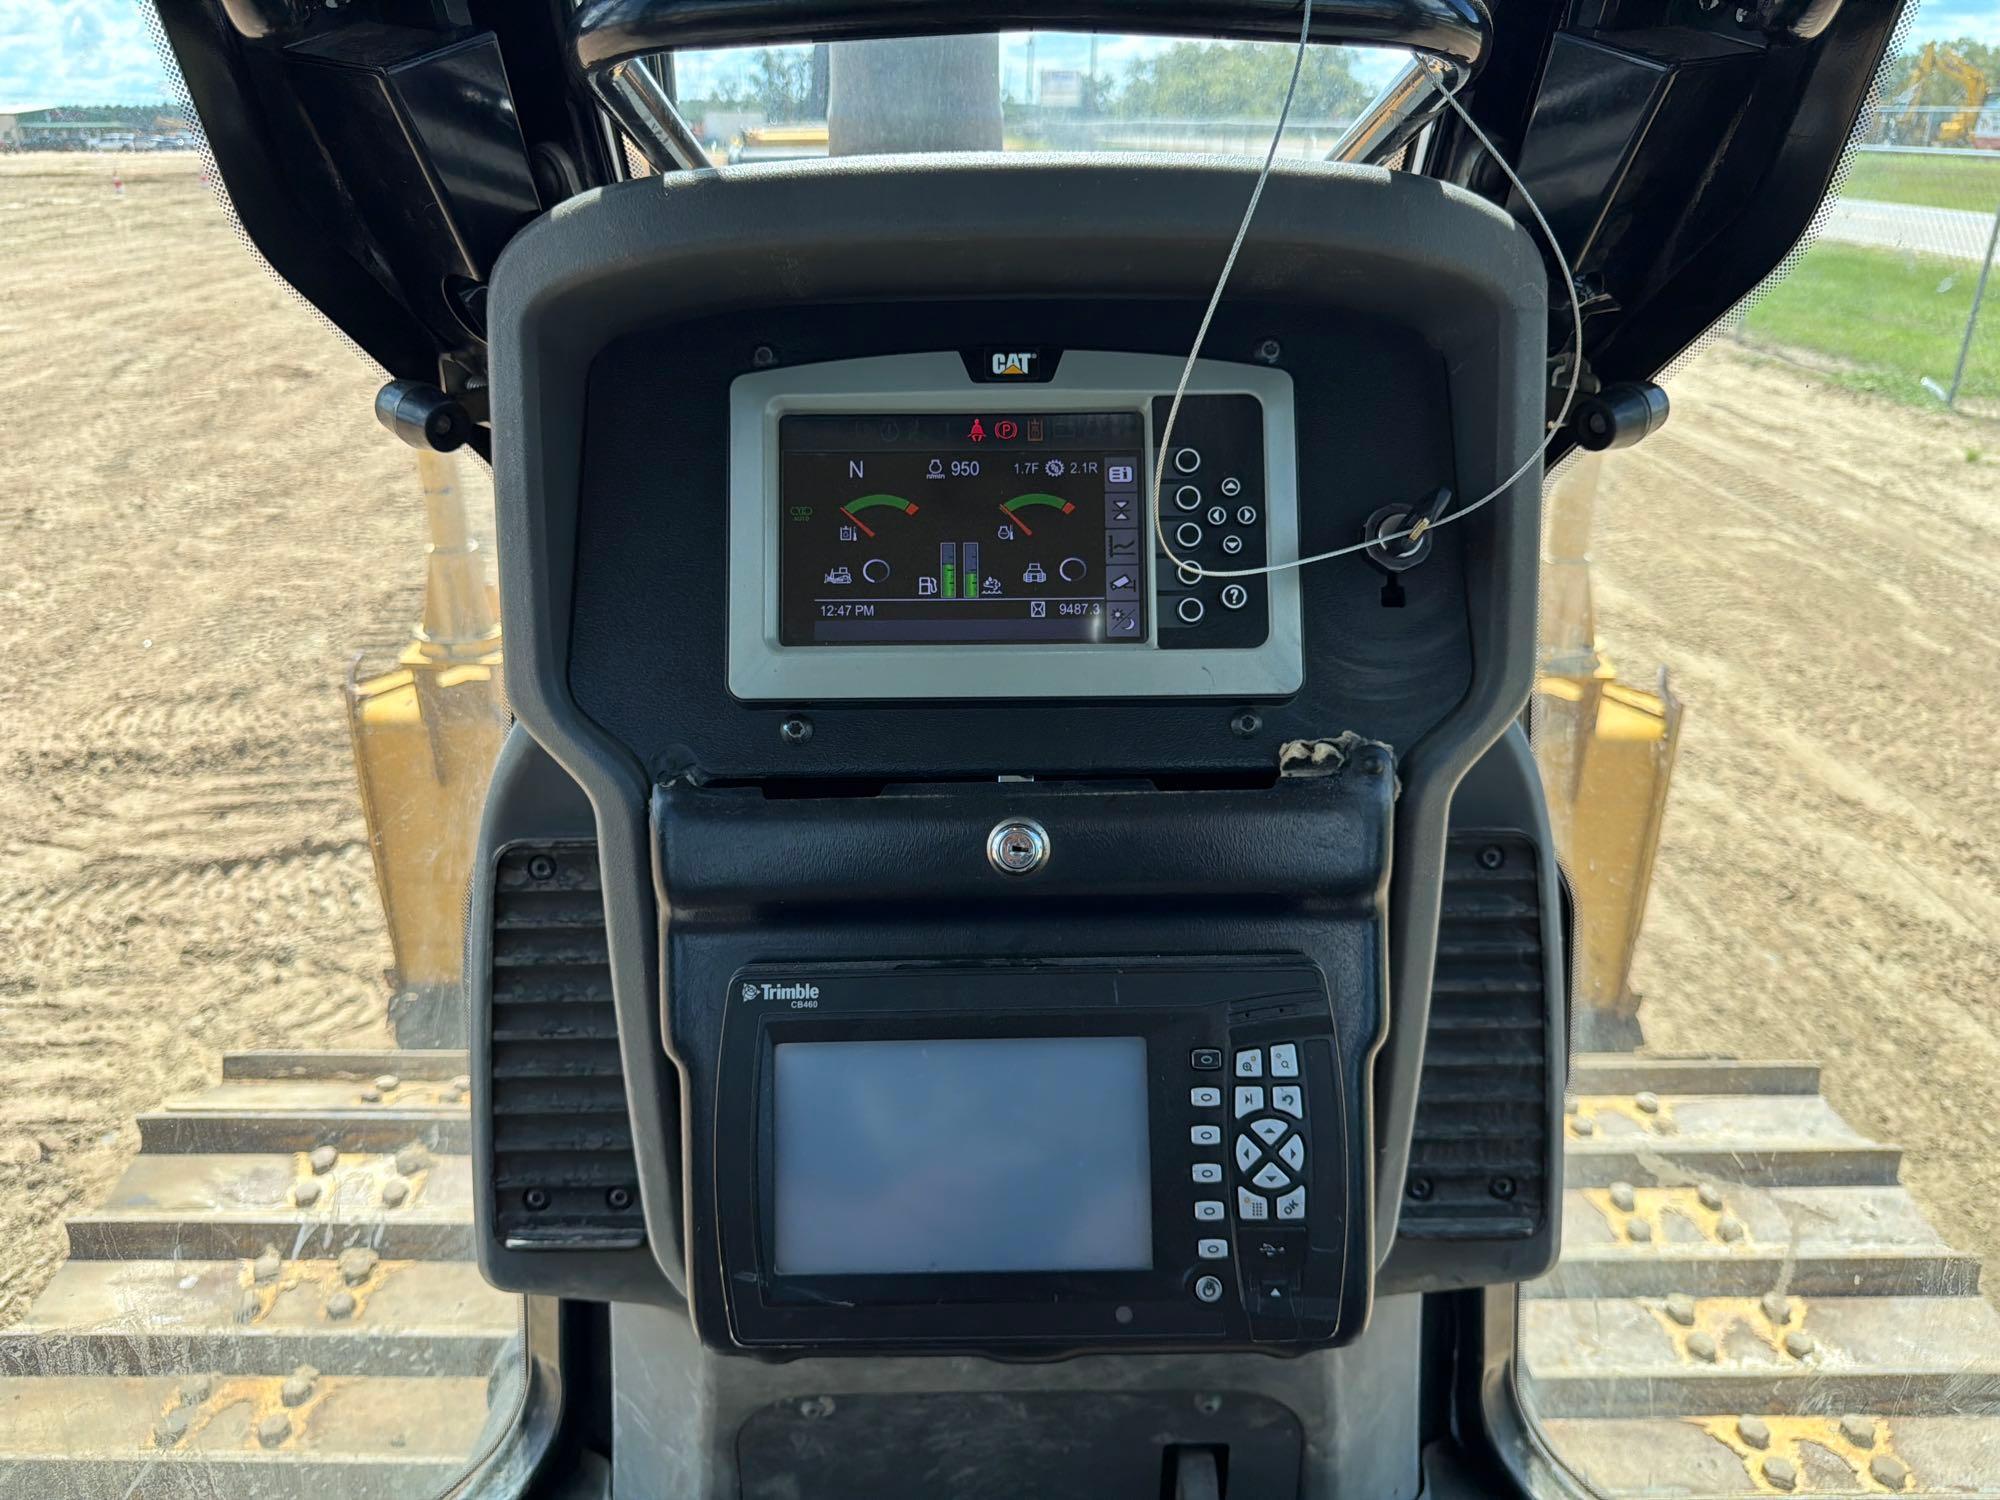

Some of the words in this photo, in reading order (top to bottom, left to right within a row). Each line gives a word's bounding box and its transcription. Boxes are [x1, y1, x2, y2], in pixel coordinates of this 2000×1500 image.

[992, 353, 1032, 374] CAT
[849, 460, 863, 479] N
[951, 461, 980, 476] 950
[1013, 462, 1039, 475] 1.7F
[1070, 462, 1098, 474] 2.1R
[1229, 588, 1241, 604] ?
[820, 605, 852, 618] 12:47
[855, 605, 875, 617] PM
[1058, 603, 1100, 617] 9487.3
[760, 983, 819, 1000] Trimble
[791, 1000, 818, 1009] CB460
[1283, 1199, 1299, 1216] OK
